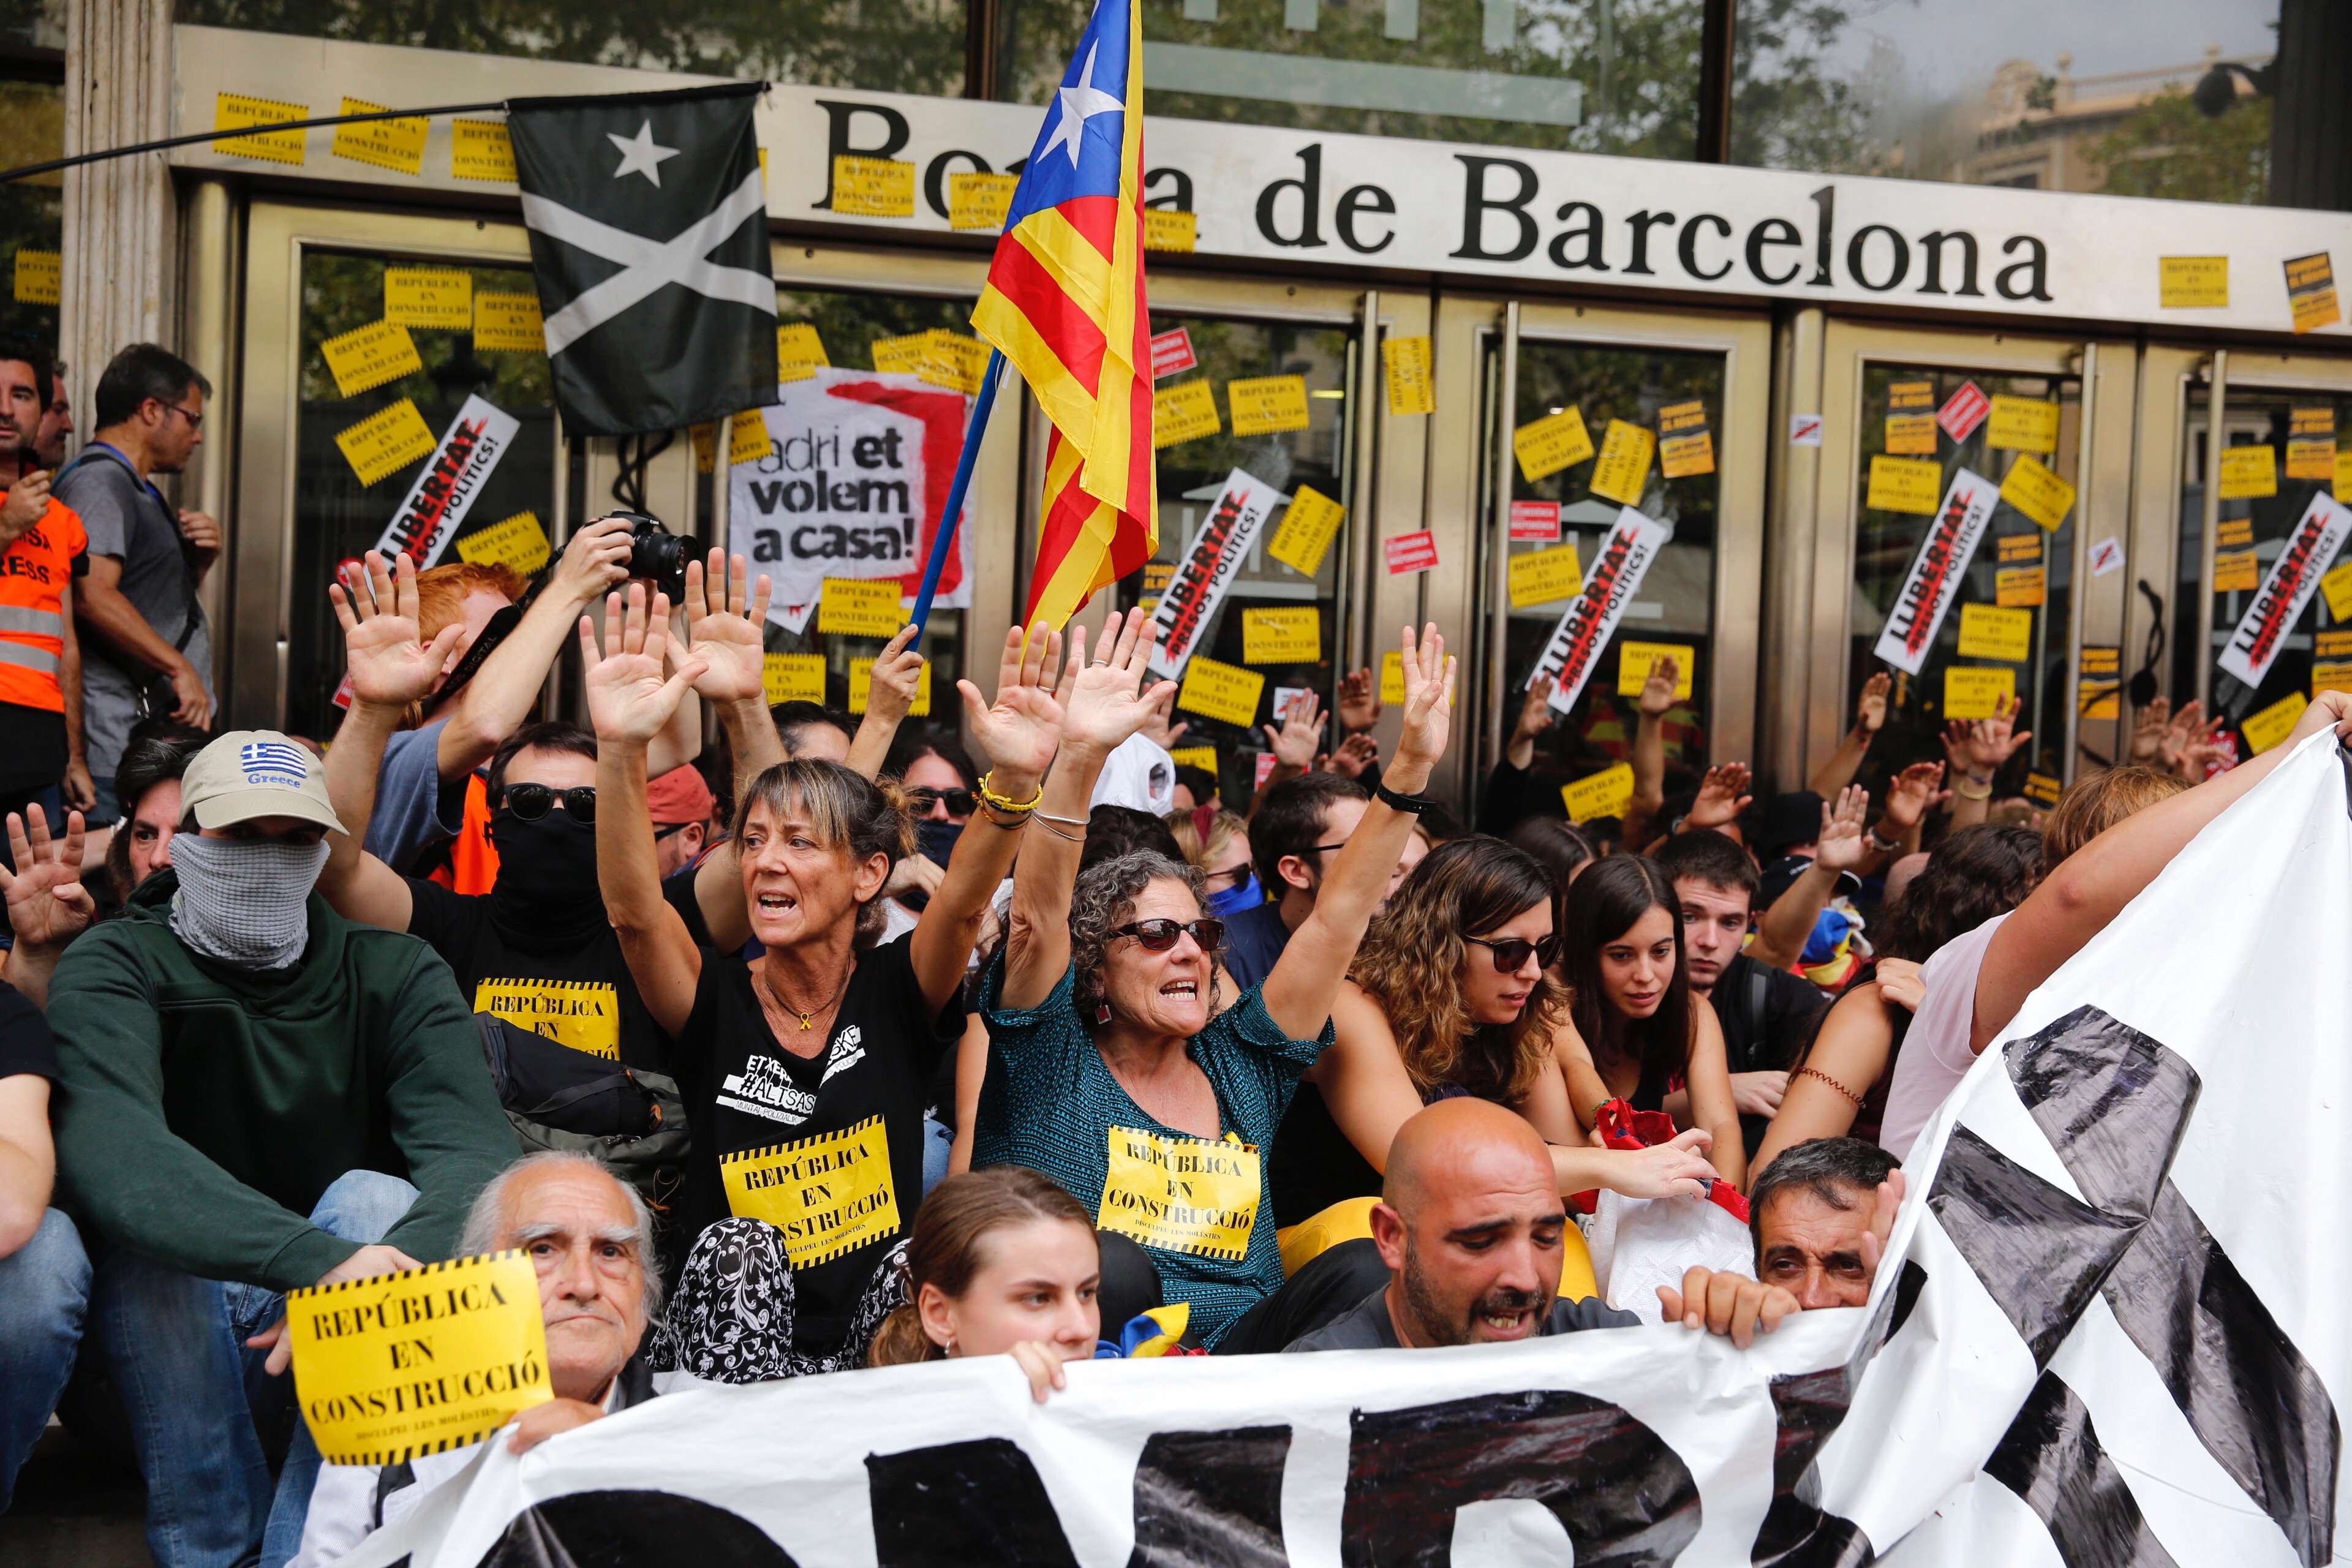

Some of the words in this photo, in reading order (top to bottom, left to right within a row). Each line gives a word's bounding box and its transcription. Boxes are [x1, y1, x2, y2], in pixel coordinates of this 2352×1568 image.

[812, 100, 1200, 240] Boa
[1255, 143, 1396, 254] de
[1449, 153, 2053, 302] Barcelona
[853, 427, 903, 469] et
[748, 470, 909, 514] volem
[753, 529, 782, 562] a
[791, 517, 914, 560] casa!
[830, 584, 892, 599] REPÚBLICA
[853, 600, 867, 609] EN
[248, 774, 300, 788] Greece
[490, 992, 605, 1017] REPÚBLICA
[534, 1022, 559, 1038] EN
[744, 1142, 869, 1191] REPÚBLICA
[1126, 1142, 1242, 1177] REPÚBLICA
[801, 1182, 832, 1208] EN
[1167, 1179, 1194, 1199] EN
[1109, 1188, 1250, 1231] CONSTRUCCIÓ
[786, 1242, 819, 1254] SCULPEU
[821, 1237, 834, 1246] LES
[835, 1223, 866, 1240] MOLÈSTIES
[1135, 1219, 1169, 1234] DISCULPEU
[1186, 1231, 1221, 1240] MOLÈSTIES
[312, 1281, 509, 1341] REPÚBLICA
[389, 1335, 435, 1370] EN
[310, 1350, 540, 1426] CONSTRUCCIÓ
[415, 1419, 435, 1432] LES
